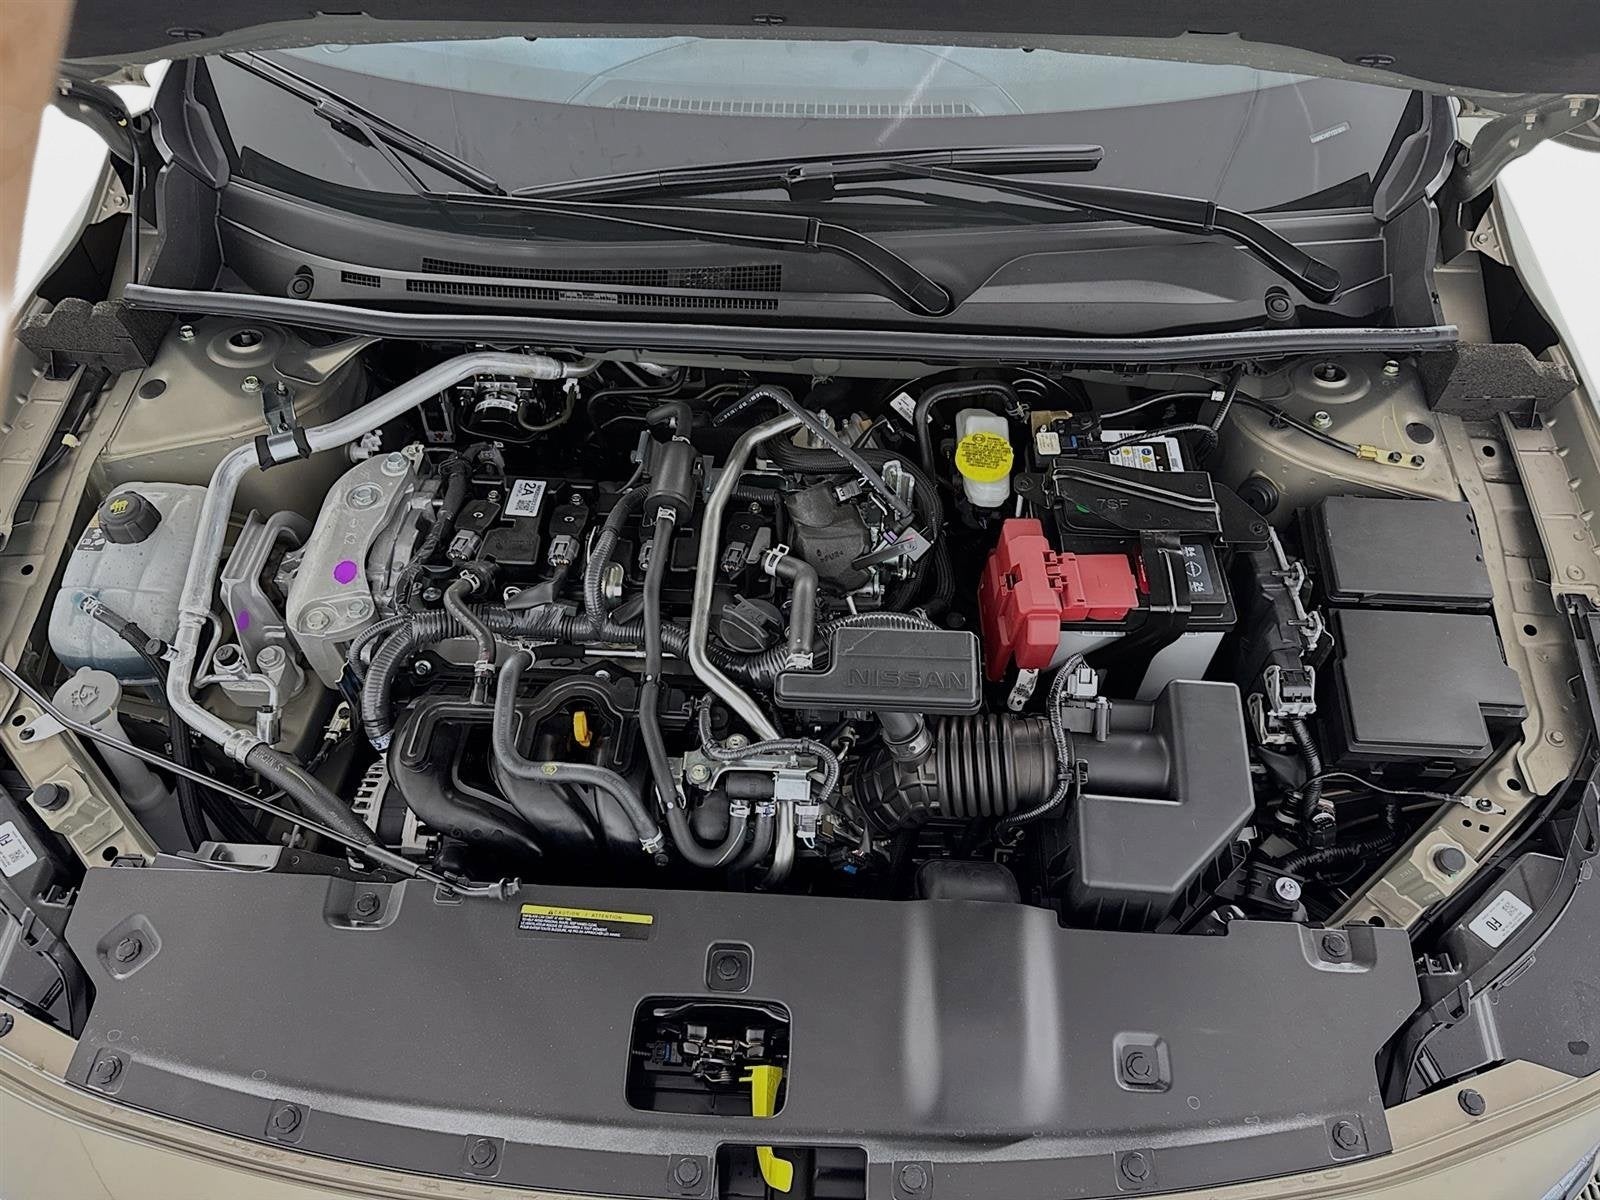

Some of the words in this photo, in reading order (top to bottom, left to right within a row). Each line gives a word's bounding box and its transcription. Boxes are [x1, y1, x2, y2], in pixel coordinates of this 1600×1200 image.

[522, 483, 537, 496] 2A
[1096, 498, 1129, 510] 7SF
[847, 668, 971, 691] NISSAN
[554, 909, 580, 917] CAUTION
[591, 912, 623, 920] ATTENTION
